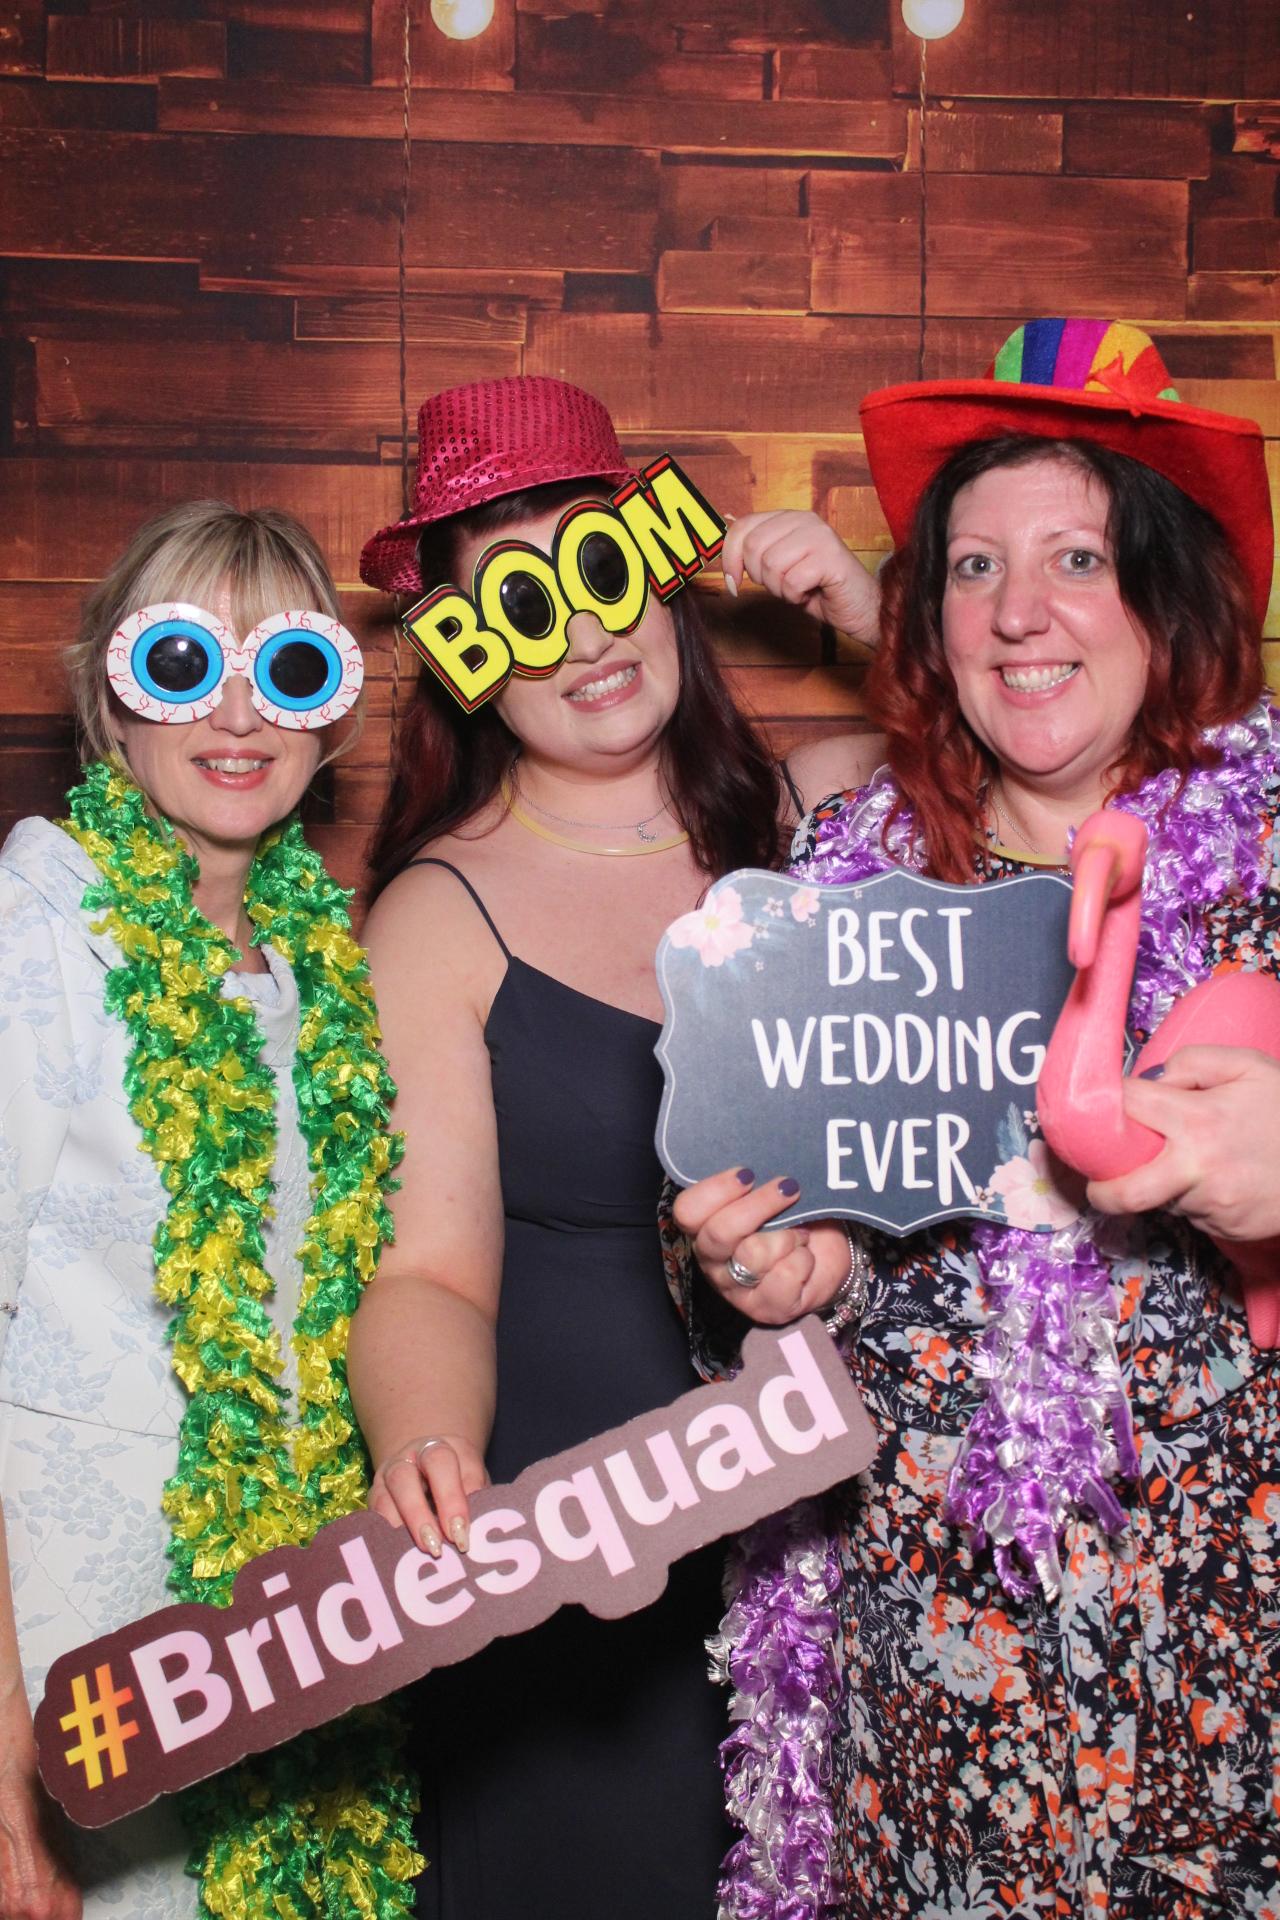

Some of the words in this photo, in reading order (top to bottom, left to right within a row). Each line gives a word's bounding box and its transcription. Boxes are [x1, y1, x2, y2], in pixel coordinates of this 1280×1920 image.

[404, 455, 727, 712] BOOM
[827, 907, 973, 997] BEST
[751, 1011, 1047, 1093] WEDDING
[826, 1113, 978, 1206] EVER
[59, 1331, 849, 1790] #Bridesquad
